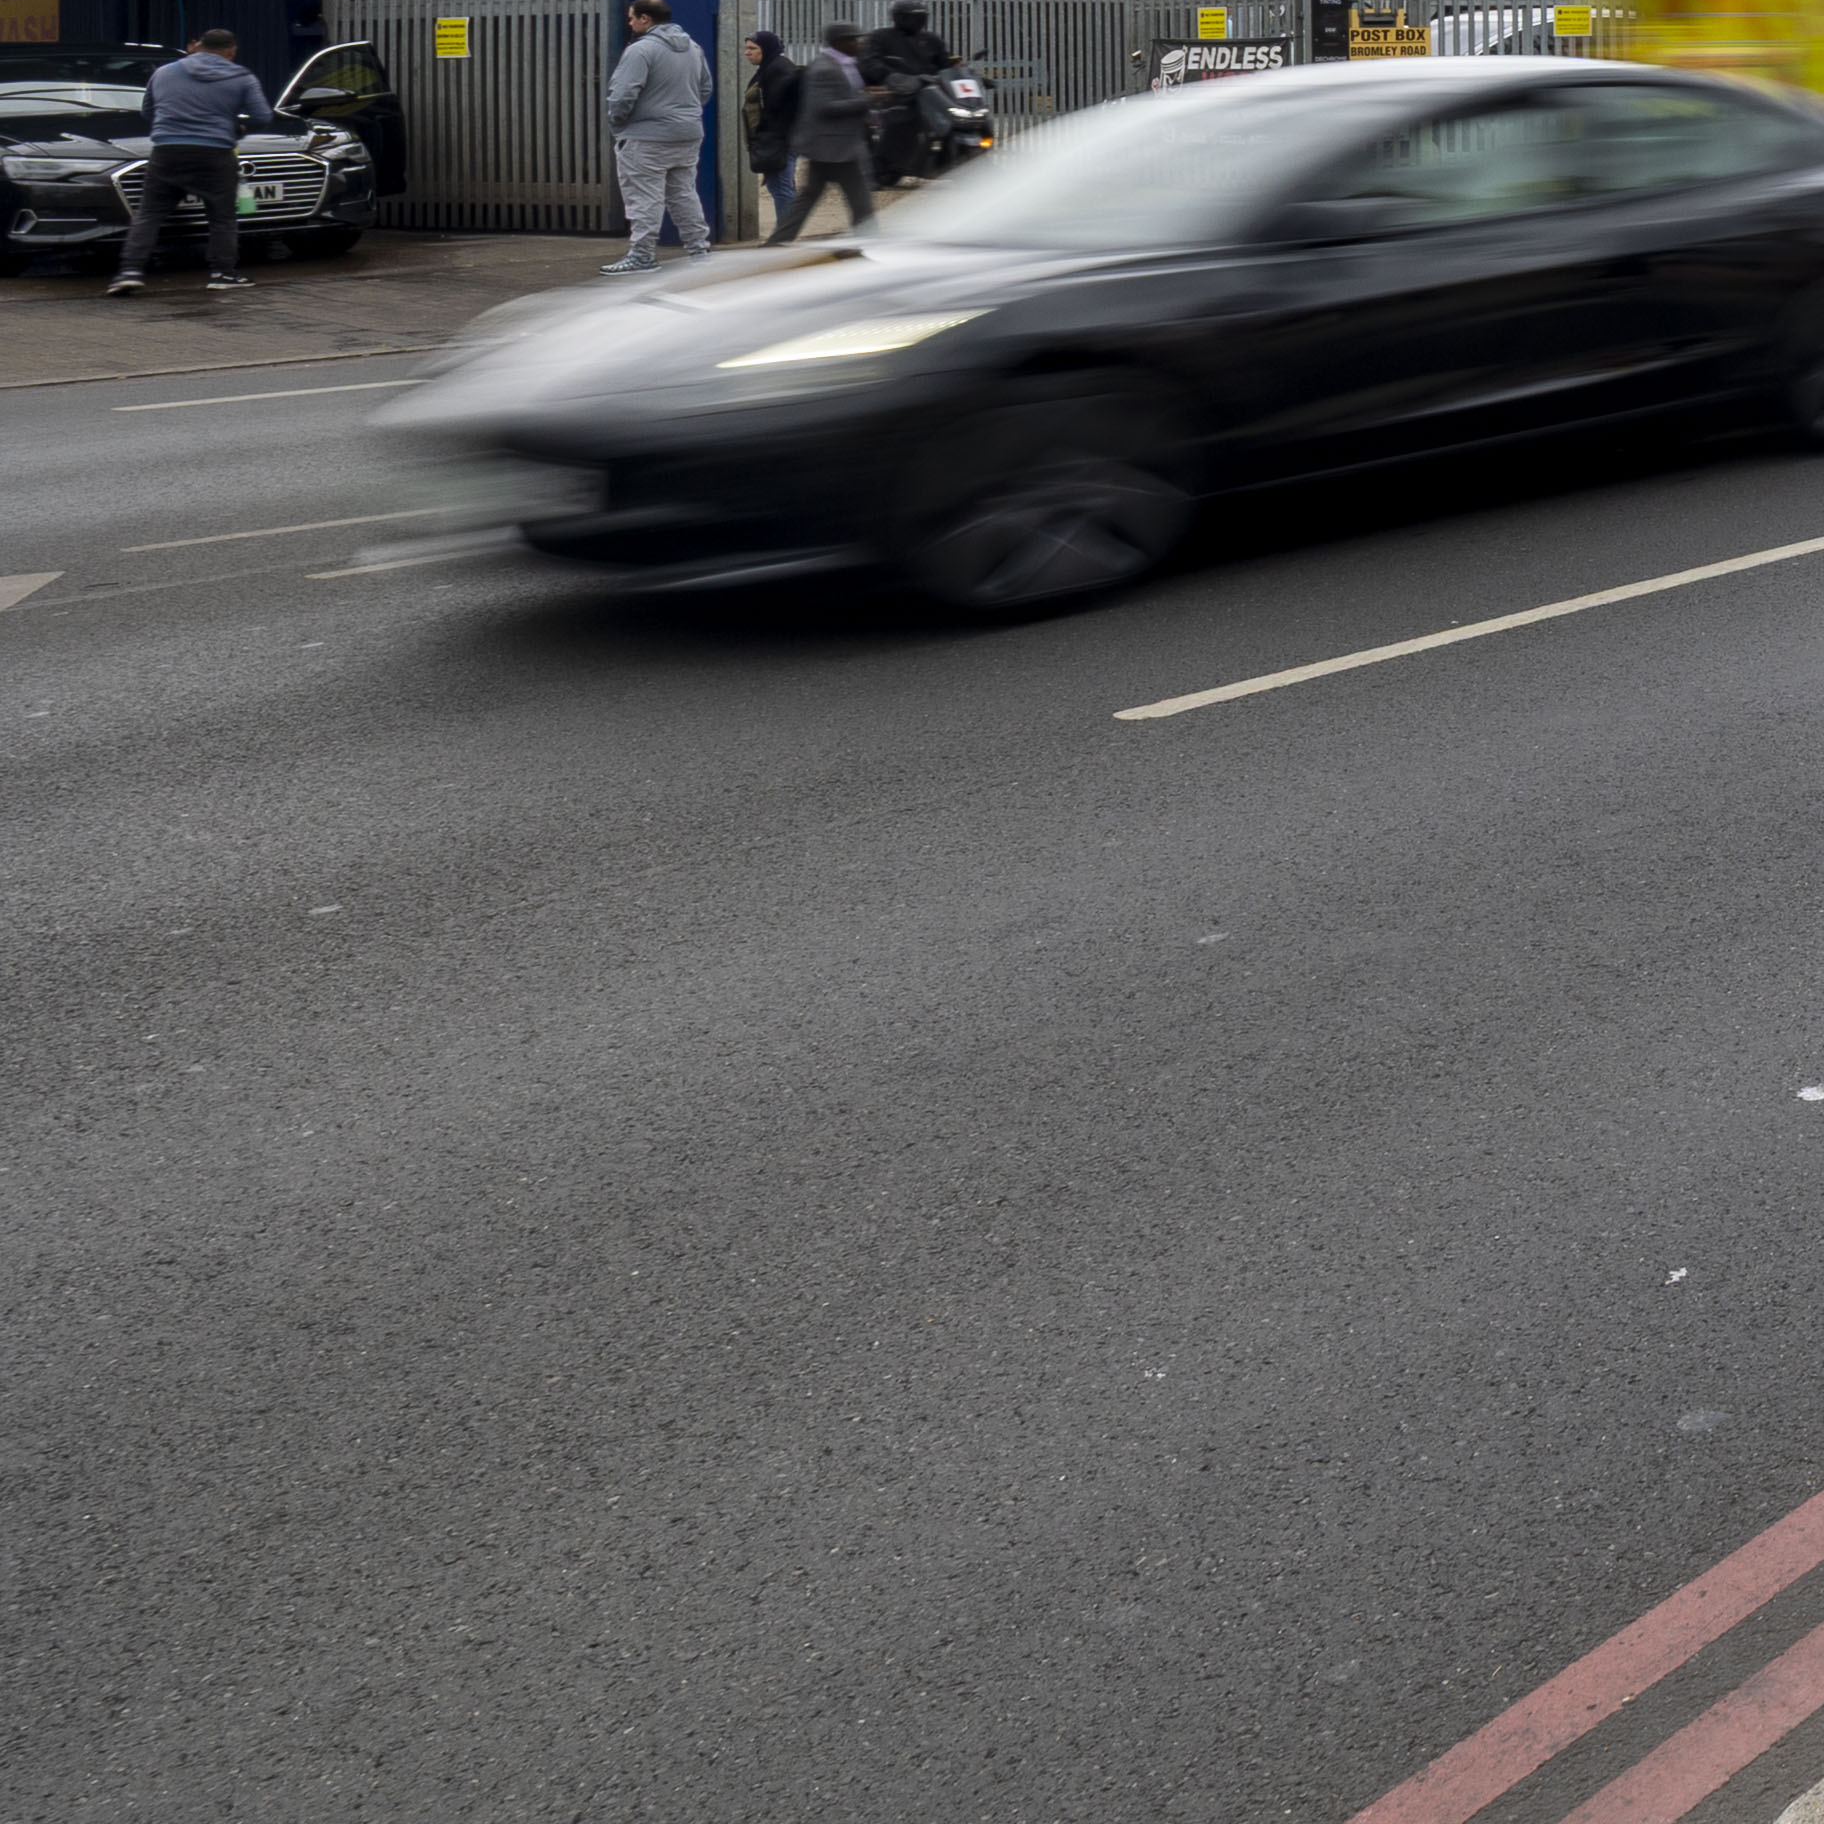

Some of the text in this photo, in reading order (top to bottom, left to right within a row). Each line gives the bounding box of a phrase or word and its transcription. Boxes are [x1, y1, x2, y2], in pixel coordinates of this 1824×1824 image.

[1350, 29, 1426, 42] POST BOX
[1187, 45, 1284, 70] ENDLESS
[1351, 45, 1427, 57] BROMLEY ROAD
